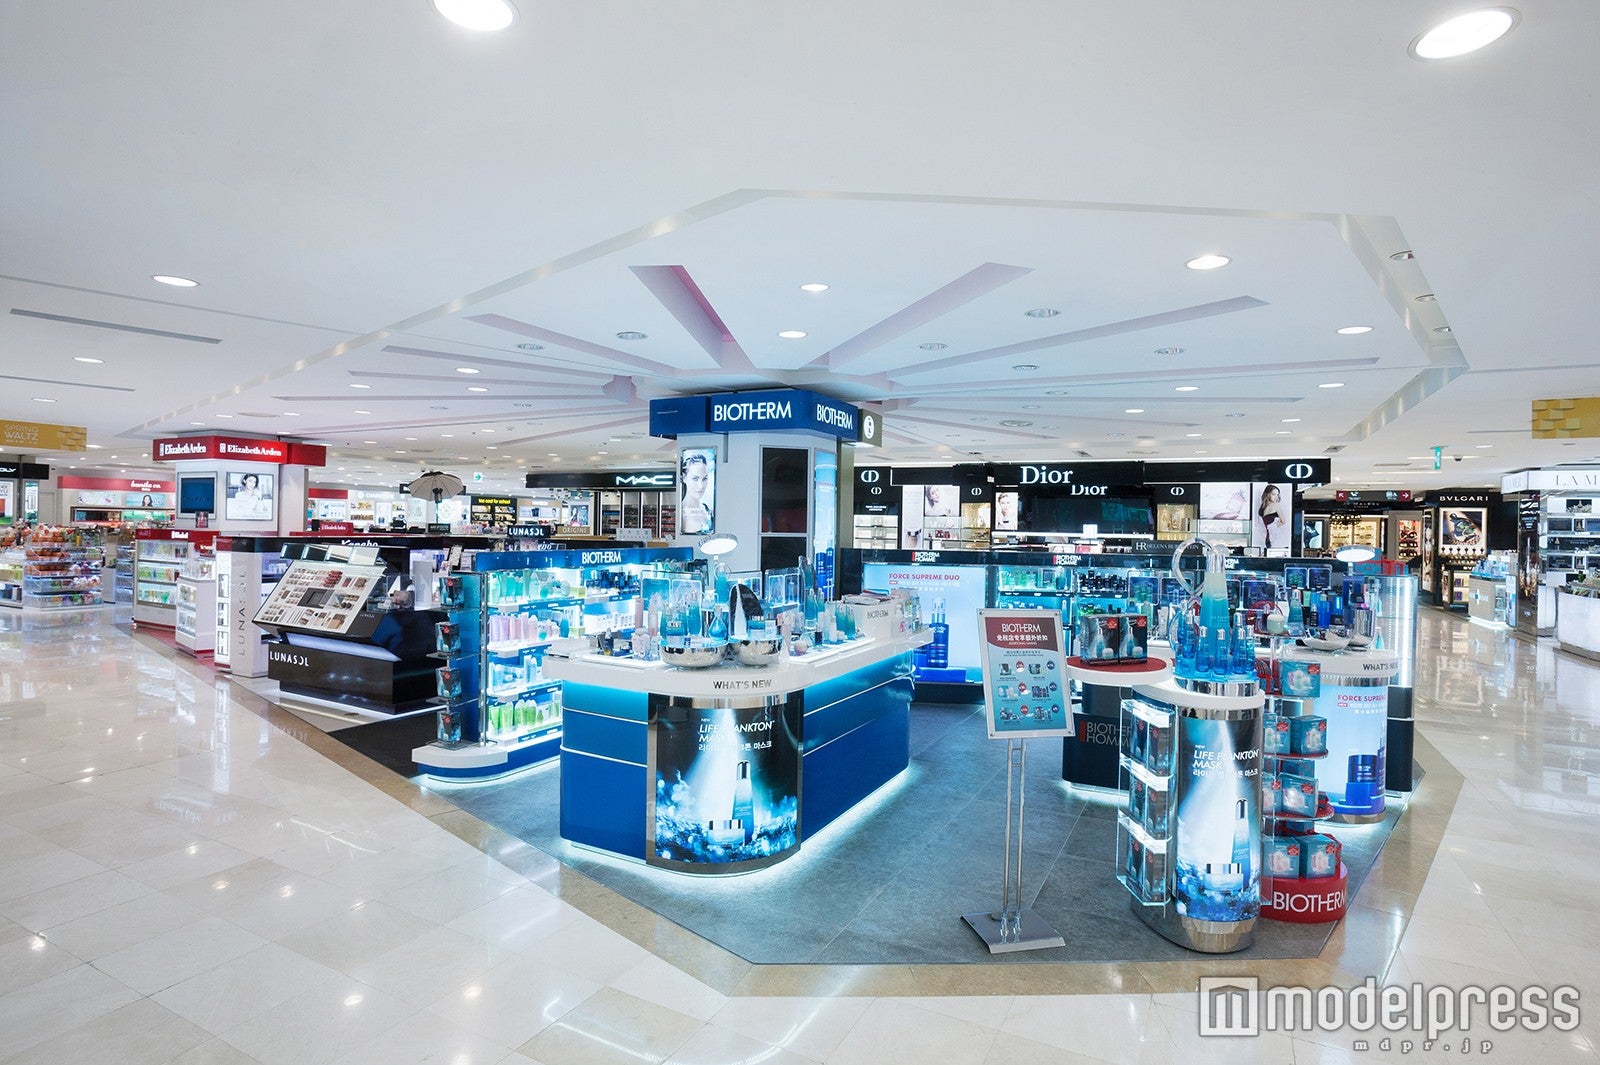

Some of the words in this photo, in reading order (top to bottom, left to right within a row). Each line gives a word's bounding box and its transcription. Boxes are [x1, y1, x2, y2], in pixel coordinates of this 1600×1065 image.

[714, 401, 792, 422] BIOTHERM
[816, 403, 853, 430] BIOTHERM
[4, 424, 39, 433] SPRING
[3, 431, 39, 440] WALTZ
[1020, 465, 1073, 484] Dior
[1070, 484, 1108, 496] Dior
[509, 528, 544, 536] LUNASOL
[581, 551, 622, 564] BIOTHERM
[867, 610, 889, 619] BIOTHERM
[1001, 623, 1041, 633] BIOTHERM
[269, 651, 309, 667] LUNASOL
[1363, 663, 1389, 671] WHAT'S
[713, 681, 750, 689] WHAT'S
[752, 679, 772, 688] NEW
[699, 724, 720, 733] LIFE
[722, 722, 773, 733] ANKTON
[1086, 721, 1132, 737] BIOTHER
[699, 734, 728, 744] MASK
[1086, 733, 1130, 747] HOMM
[1193, 750, 1214, 760] LIFE
[1192, 759, 1223, 770] MASK
